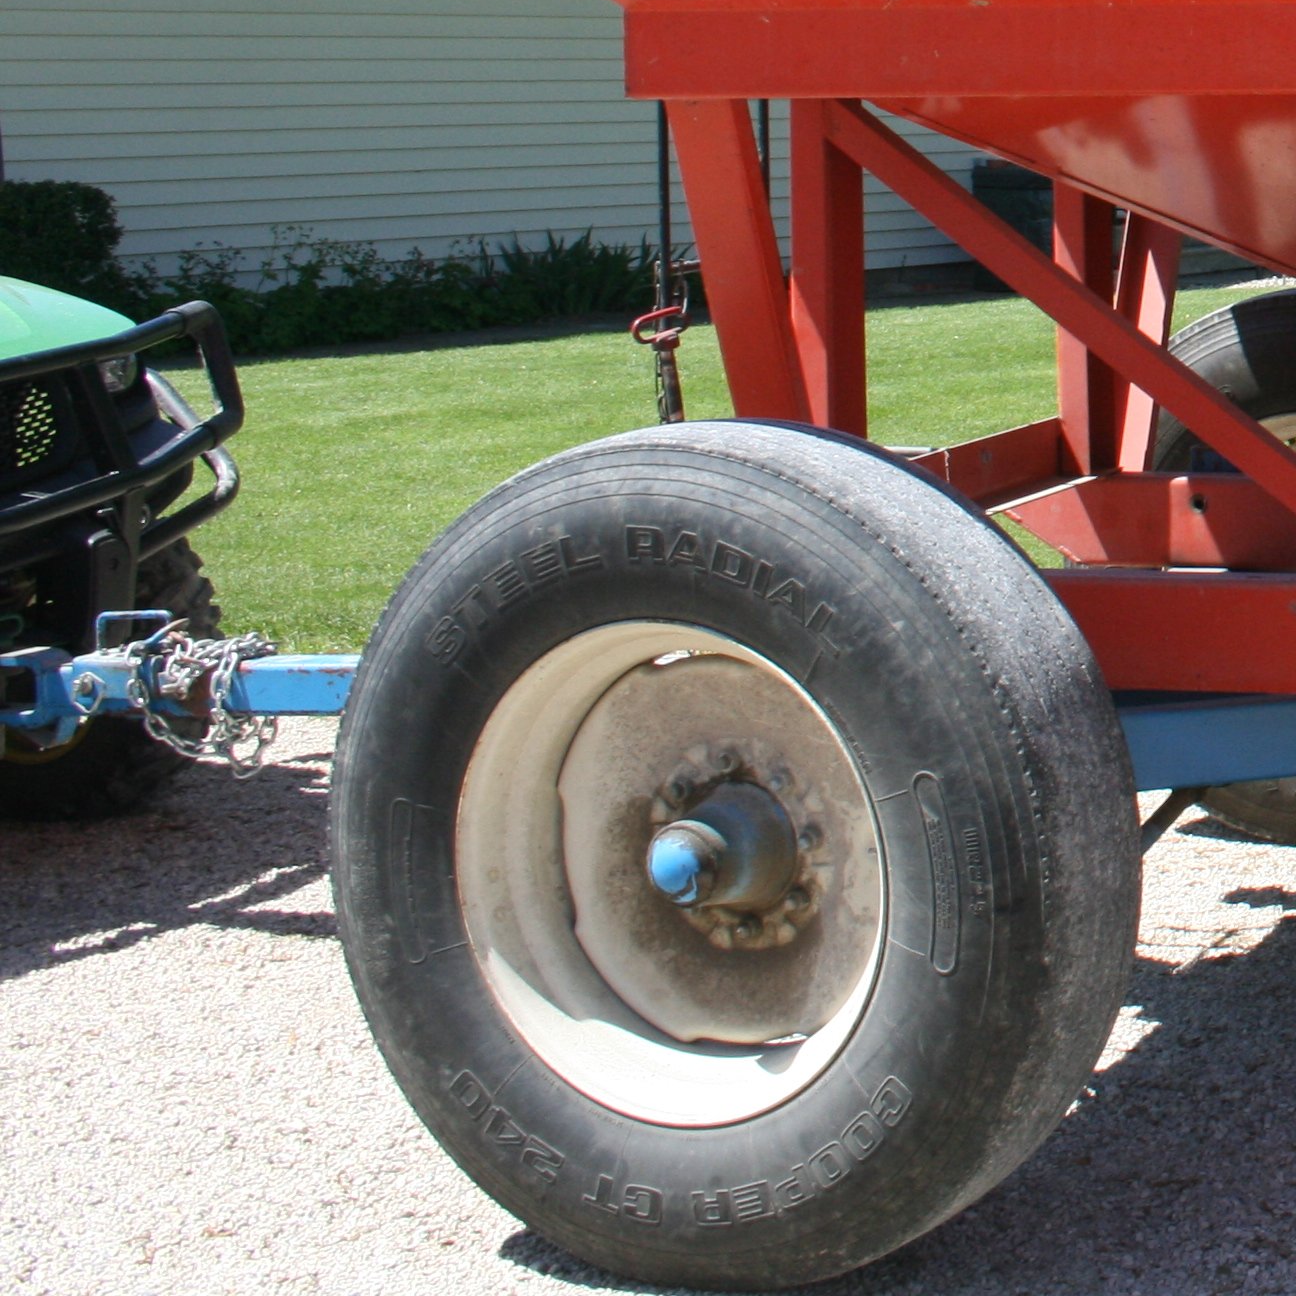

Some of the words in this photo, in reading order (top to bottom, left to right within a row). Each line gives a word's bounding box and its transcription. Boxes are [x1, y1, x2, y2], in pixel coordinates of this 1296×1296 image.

[425, 535, 602, 666] STEEL
[625, 524, 841, 659] RADIAL
[449, 1069, 566, 1184] 240
[690, 1075, 913, 1227] COOPER
